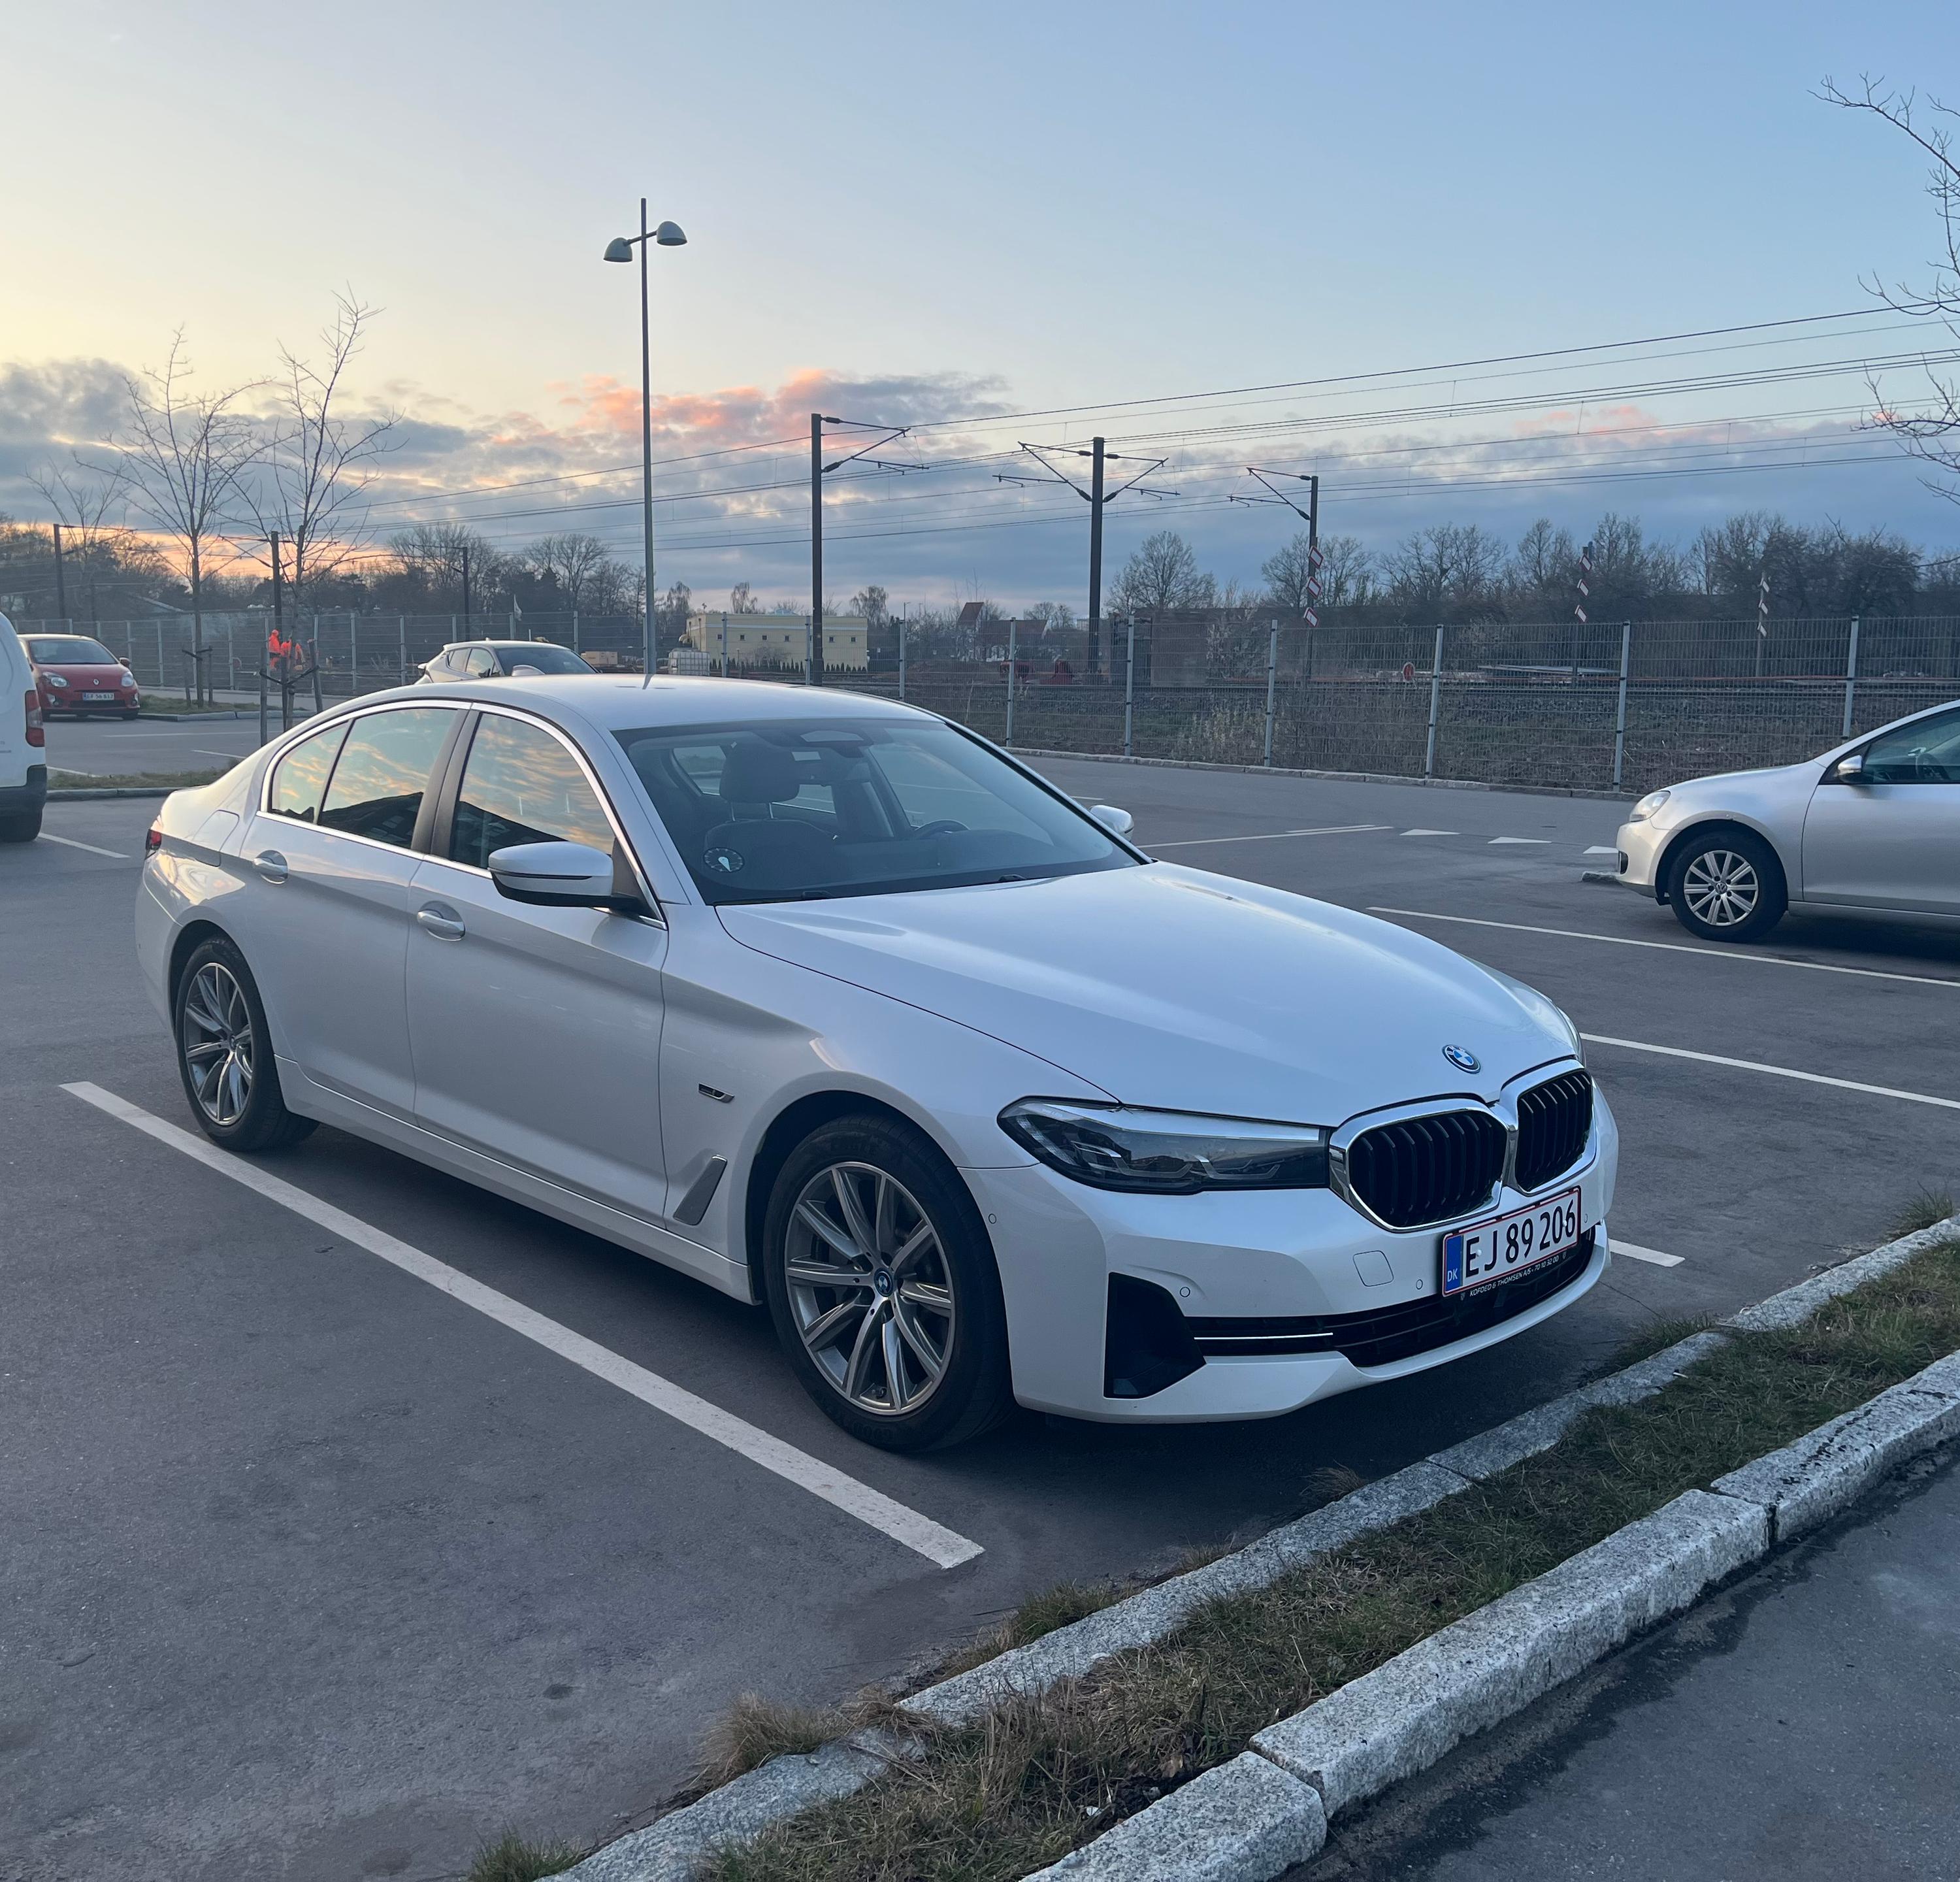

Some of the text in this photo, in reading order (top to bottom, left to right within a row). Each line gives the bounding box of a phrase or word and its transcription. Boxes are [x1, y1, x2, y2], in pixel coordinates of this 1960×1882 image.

[1465, 1198, 1576, 1278] EJ 89 206
[1447, 1268, 1458, 1282] DK
[1469, 1284, 1492, 1297] KOFOED
[1497, 1272, 1523, 1287] THOMSEN
[1523, 1267, 1531, 1277] A/S
[1552, 1255, 1560, 1263] 00
